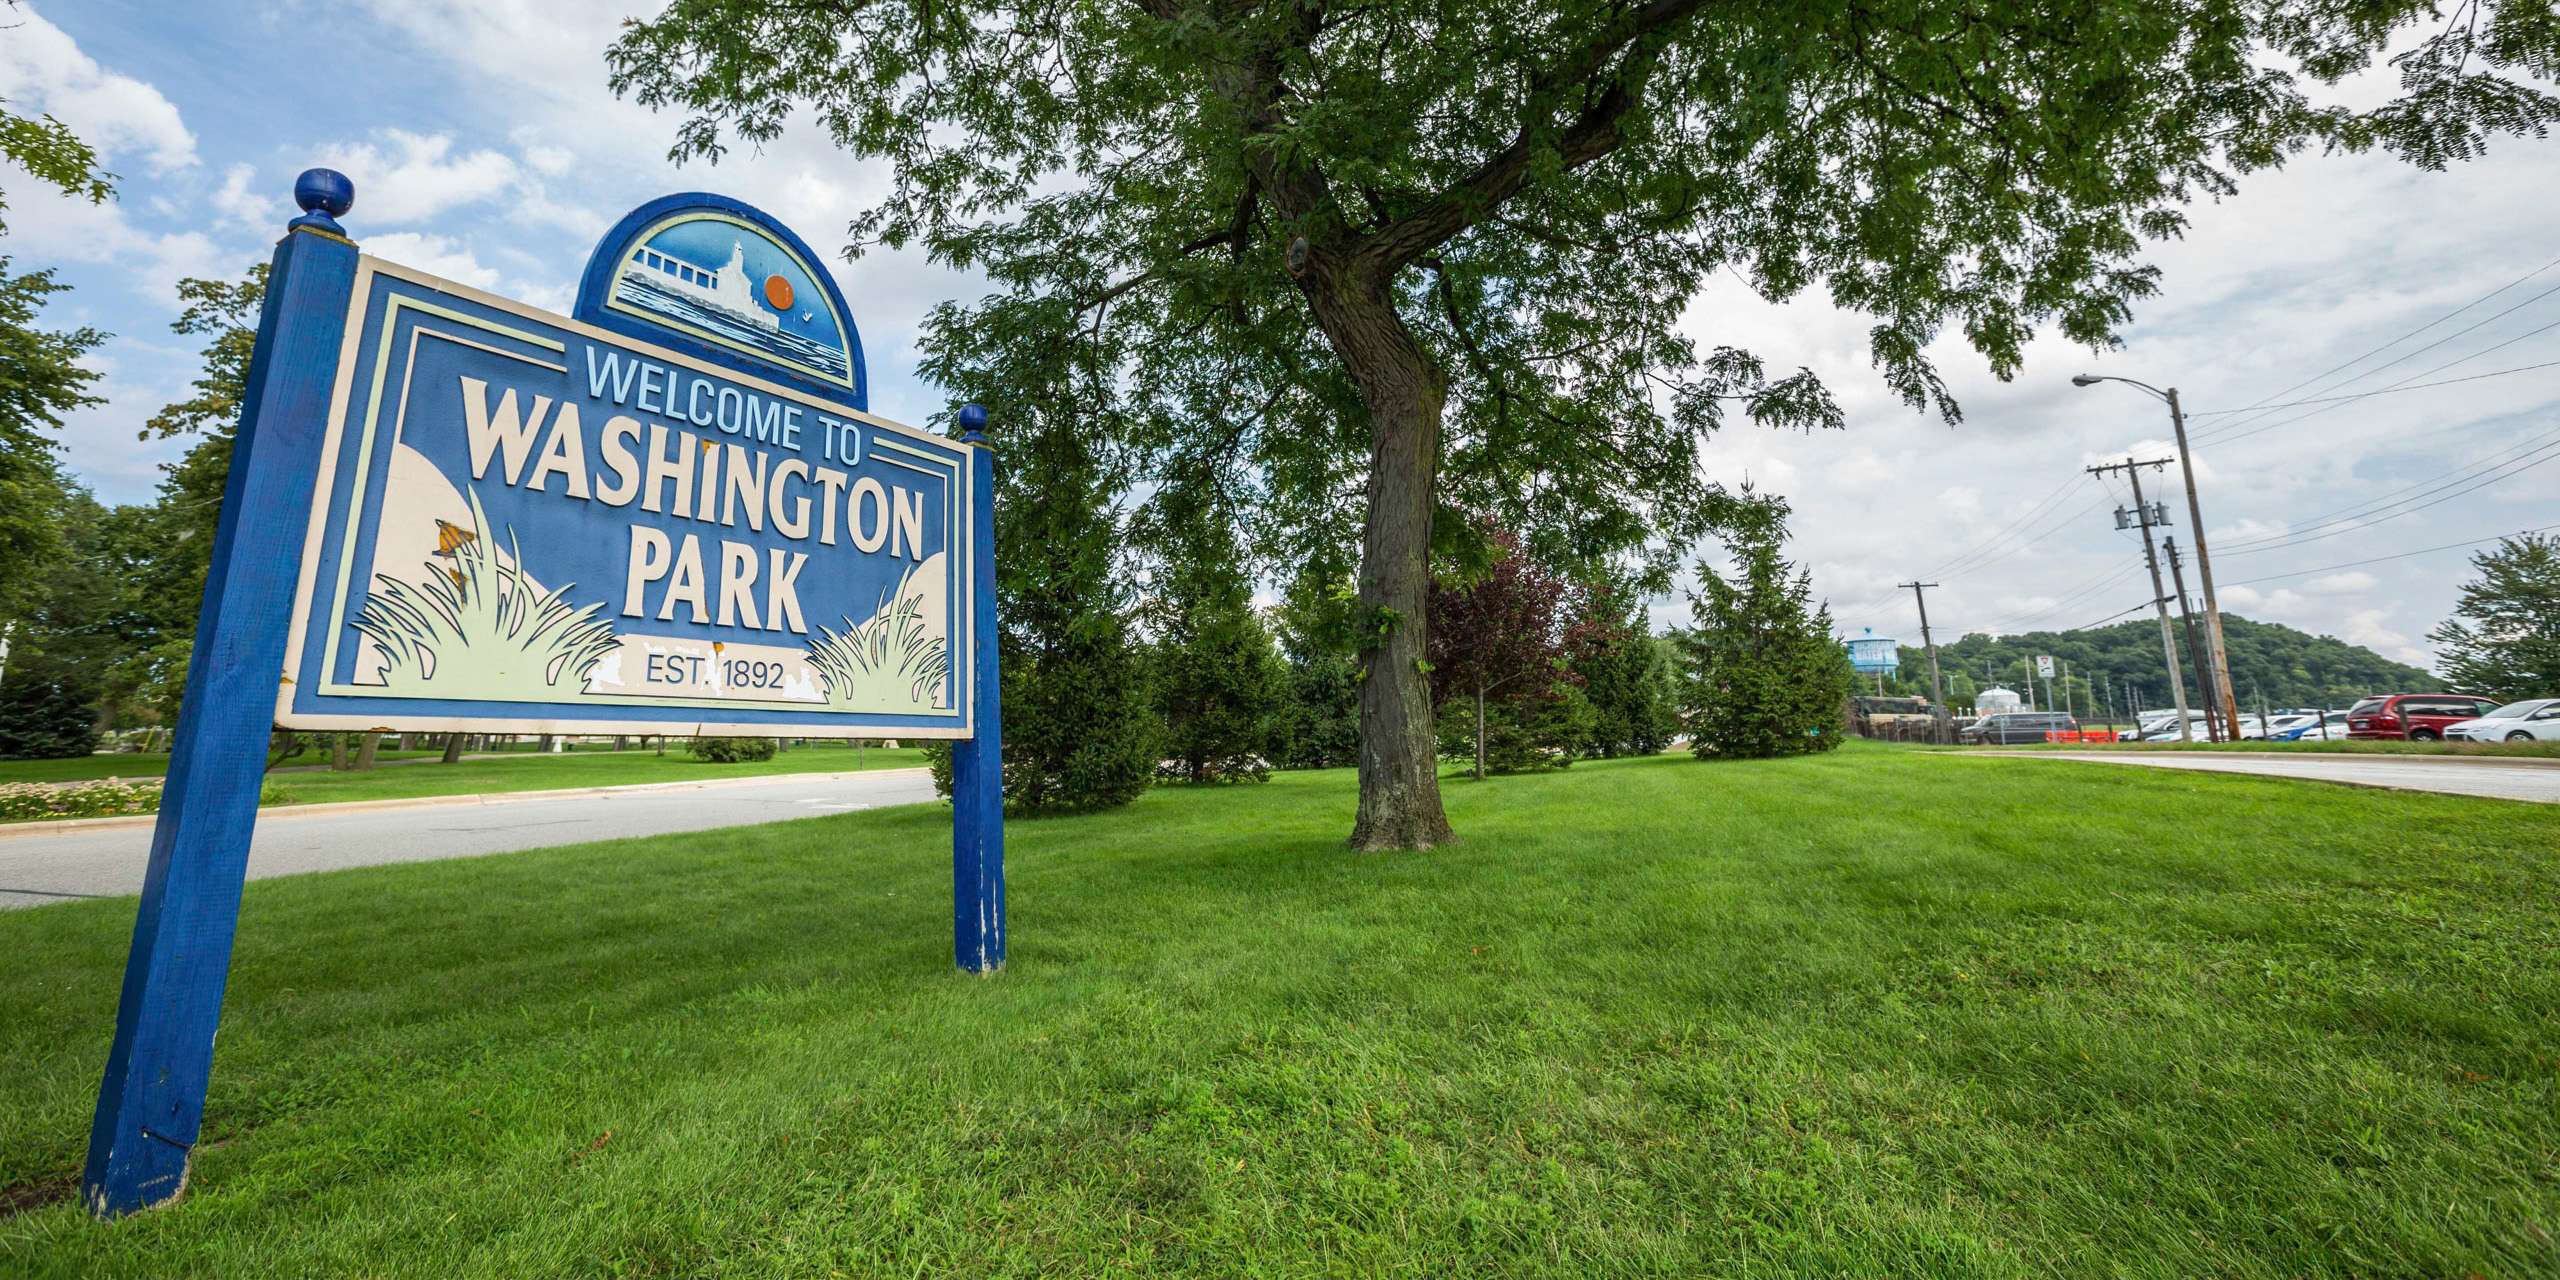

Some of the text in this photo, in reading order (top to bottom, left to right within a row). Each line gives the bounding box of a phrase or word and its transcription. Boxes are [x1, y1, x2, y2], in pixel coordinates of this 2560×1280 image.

[585, 345, 861, 466] WELCOME TO
[460, 375, 924, 562] WASHINGTON
[620, 524, 809, 634] PARK
[646, 653, 784, 689] EST. 1892
